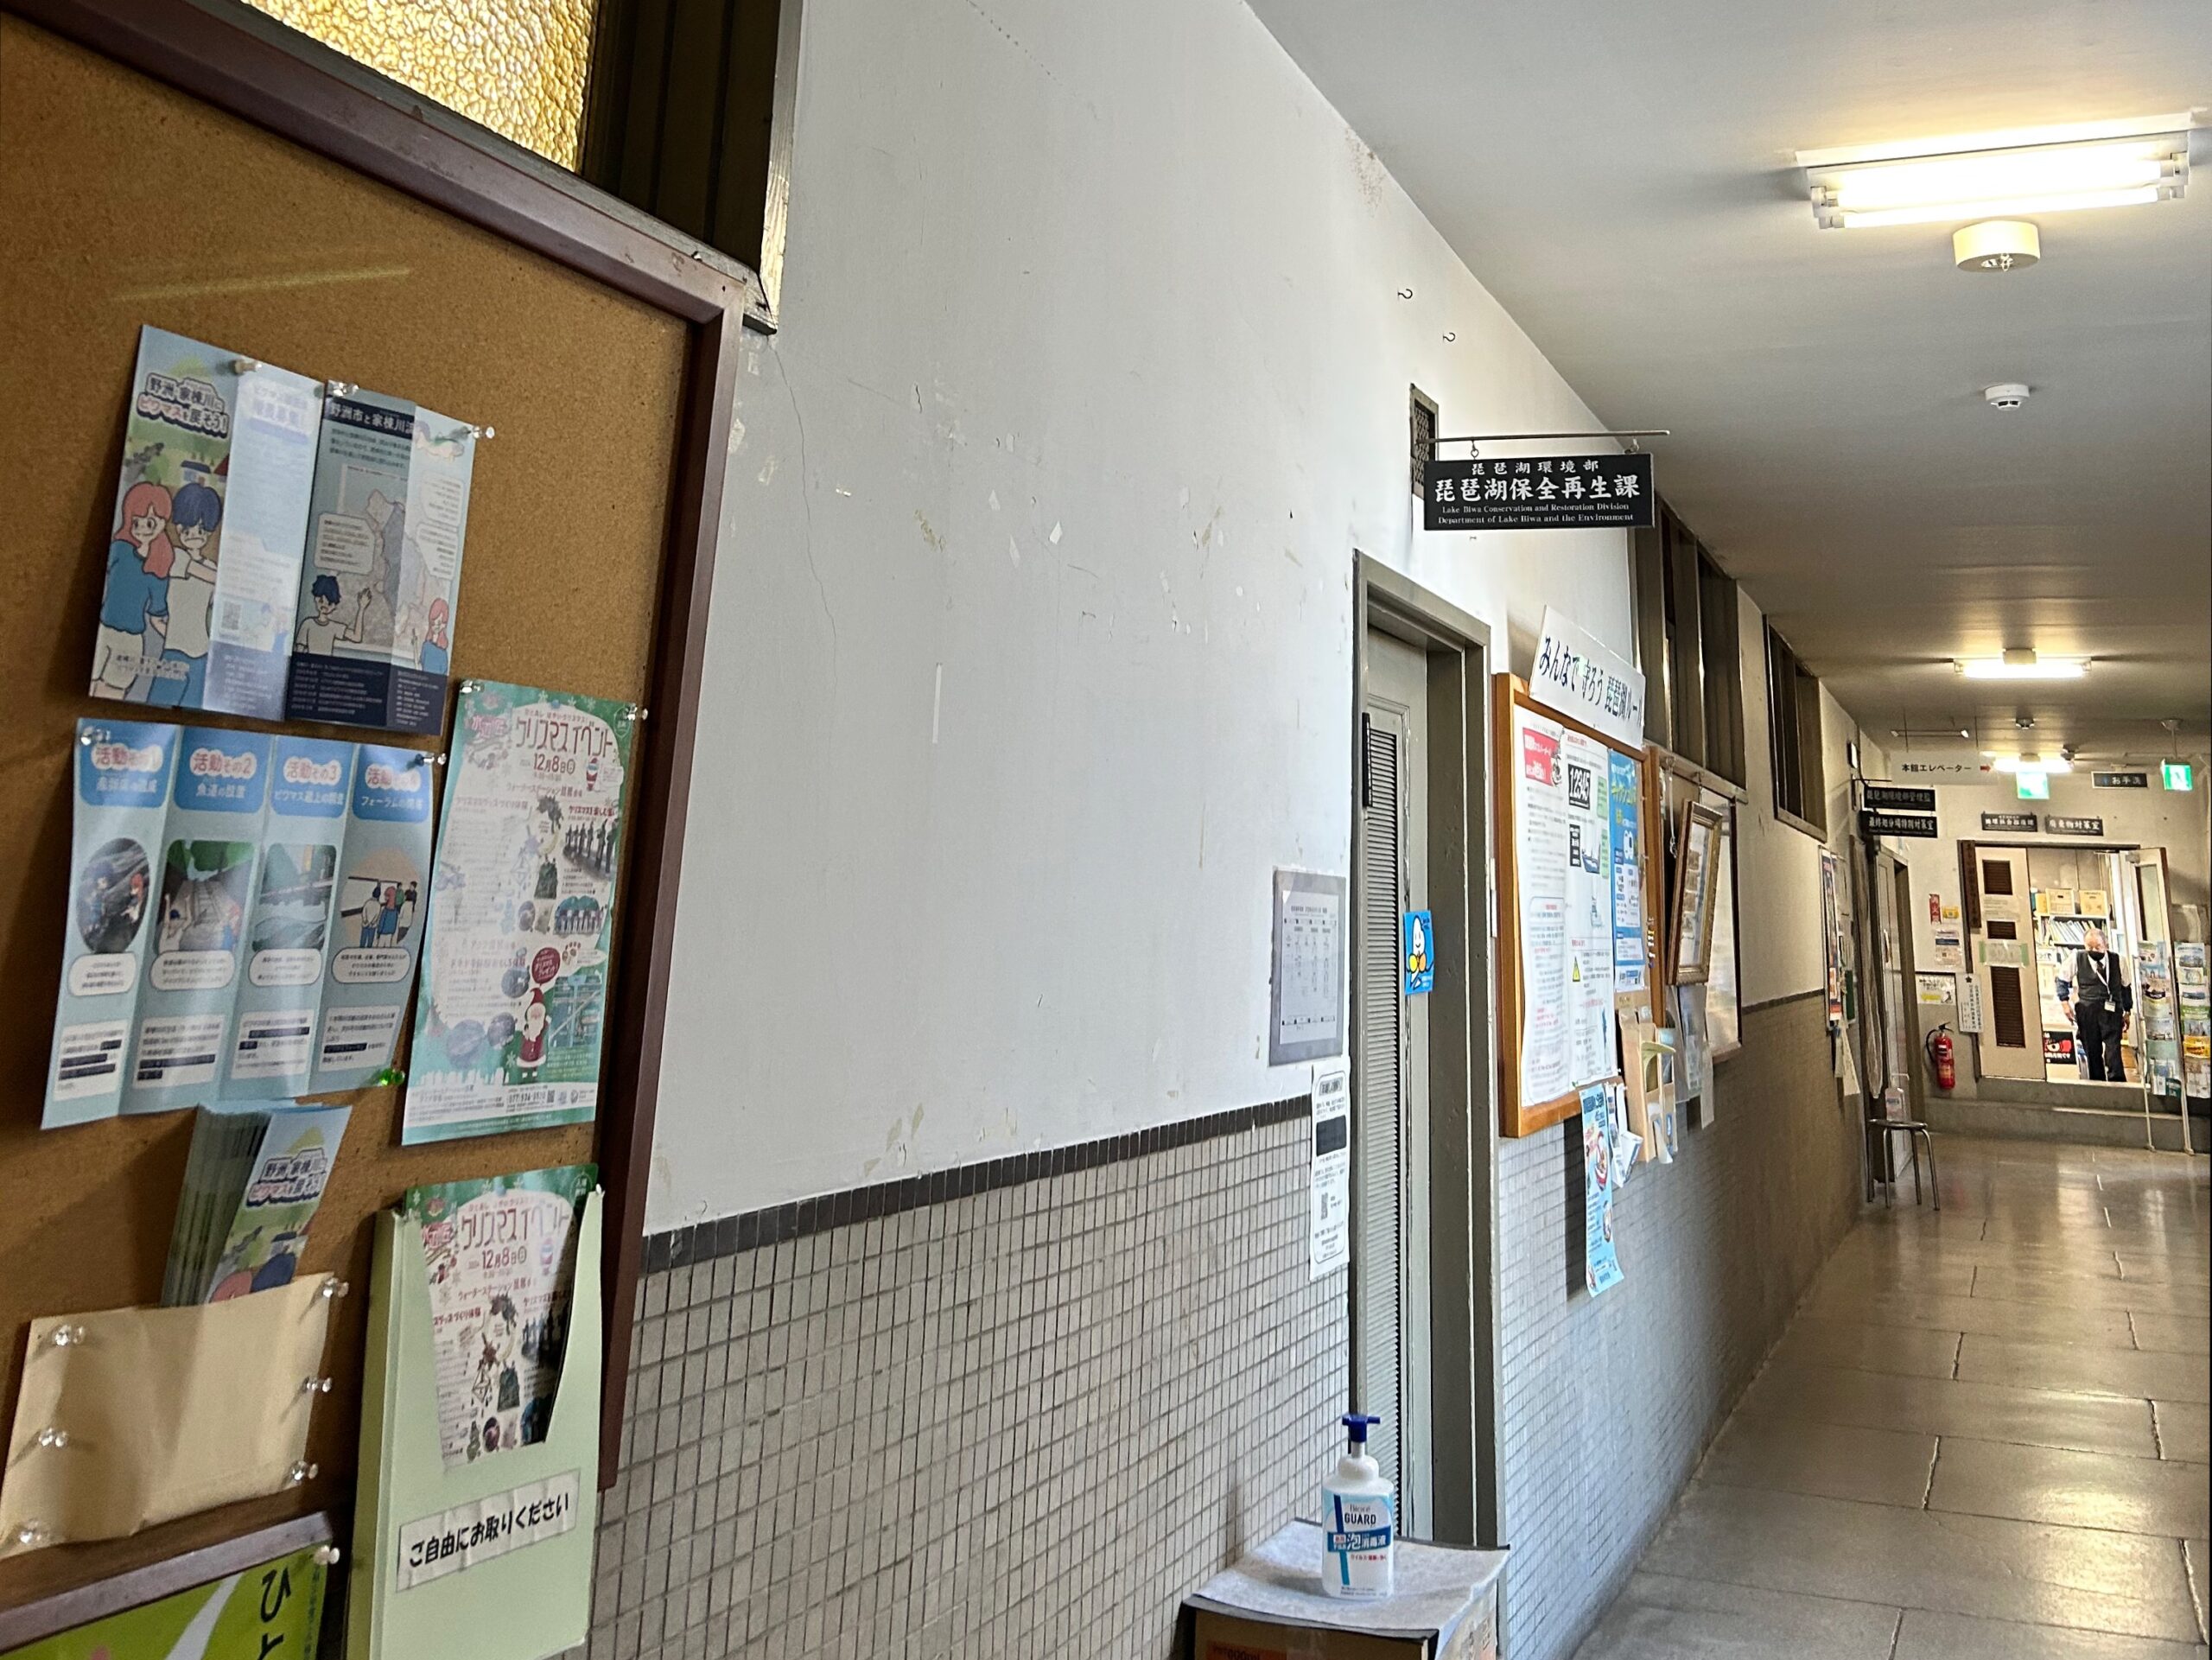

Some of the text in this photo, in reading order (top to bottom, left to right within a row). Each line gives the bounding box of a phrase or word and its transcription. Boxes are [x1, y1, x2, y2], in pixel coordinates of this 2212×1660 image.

[1471, 460, 1599, 475] 琵琶湖環境部
[1435, 474, 1640, 502] 琵琶湖保全再生課
[1597, 502, 1629, 511] Division
[1438, 516, 1484, 525] Department
[194, 753, 252, 774] 活動その2
[1344, 1512, 1376, 1526] GUARD
[410, 1492, 569, 1568] ご自由にお取りください
